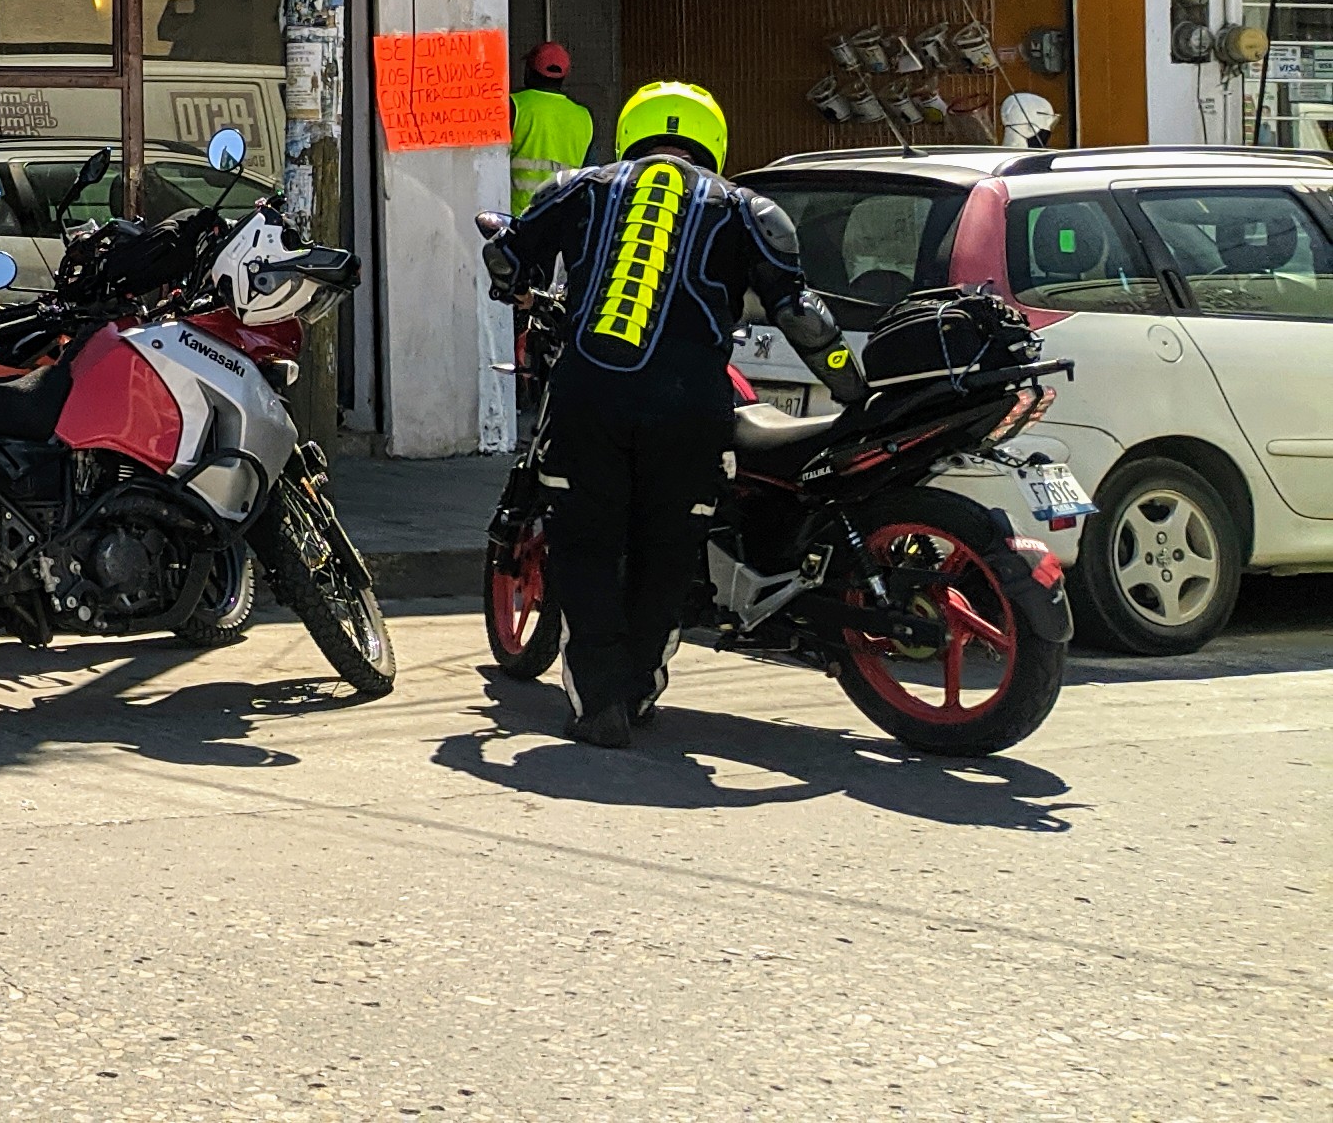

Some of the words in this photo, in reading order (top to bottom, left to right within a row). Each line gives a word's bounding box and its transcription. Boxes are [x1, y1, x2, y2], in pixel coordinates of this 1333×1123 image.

[381, 37, 407, 62] SE
[379, 67, 410, 87] LOS
[415, 61, 495, 86] TENDONES
[1279, 63, 1301, 73] VISA
[178, 330, 246, 378] Kawasaki
[802, 465, 832, 481] ITALIKA
[1029, 480, 1079, 505] F78YG
